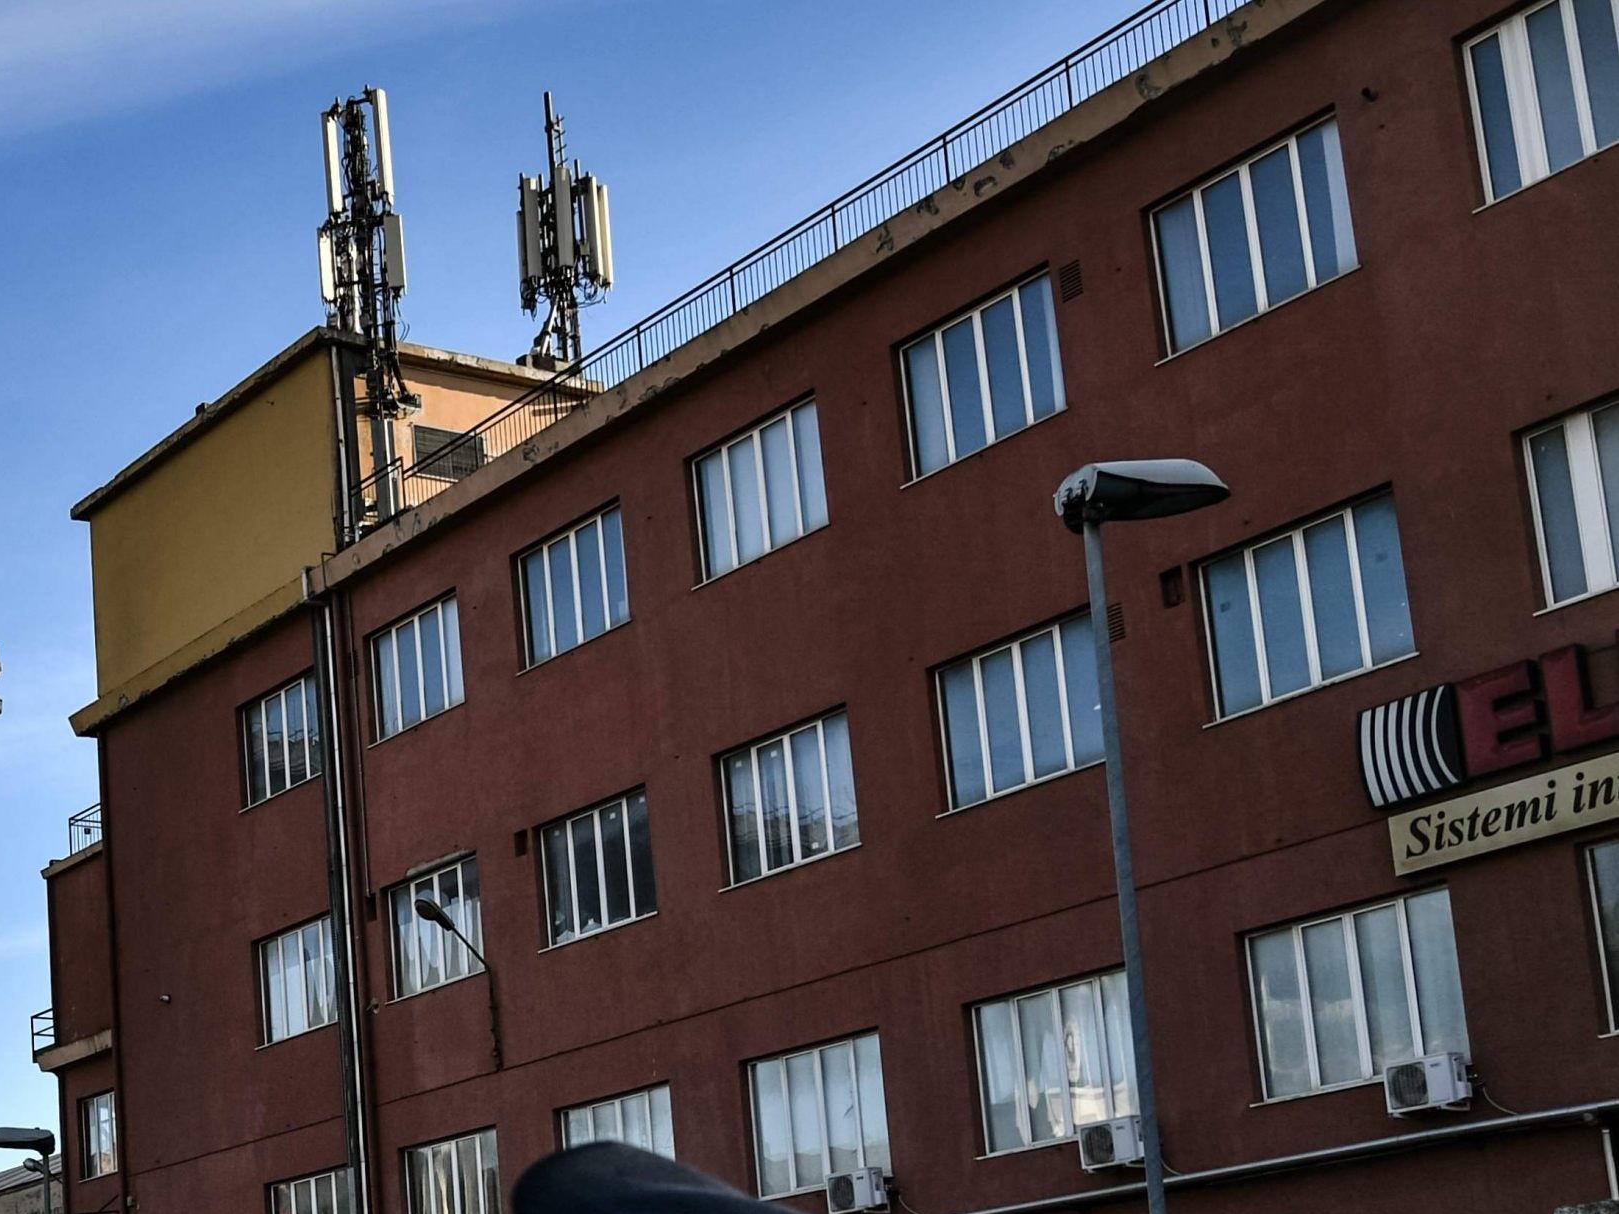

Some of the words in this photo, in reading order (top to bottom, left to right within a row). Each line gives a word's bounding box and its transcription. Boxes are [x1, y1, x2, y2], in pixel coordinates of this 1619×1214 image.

[1457, 644, 1619, 777] EL
[1406, 779, 1557, 859] Sistemi
[1572, 771, 1619, 814] in
